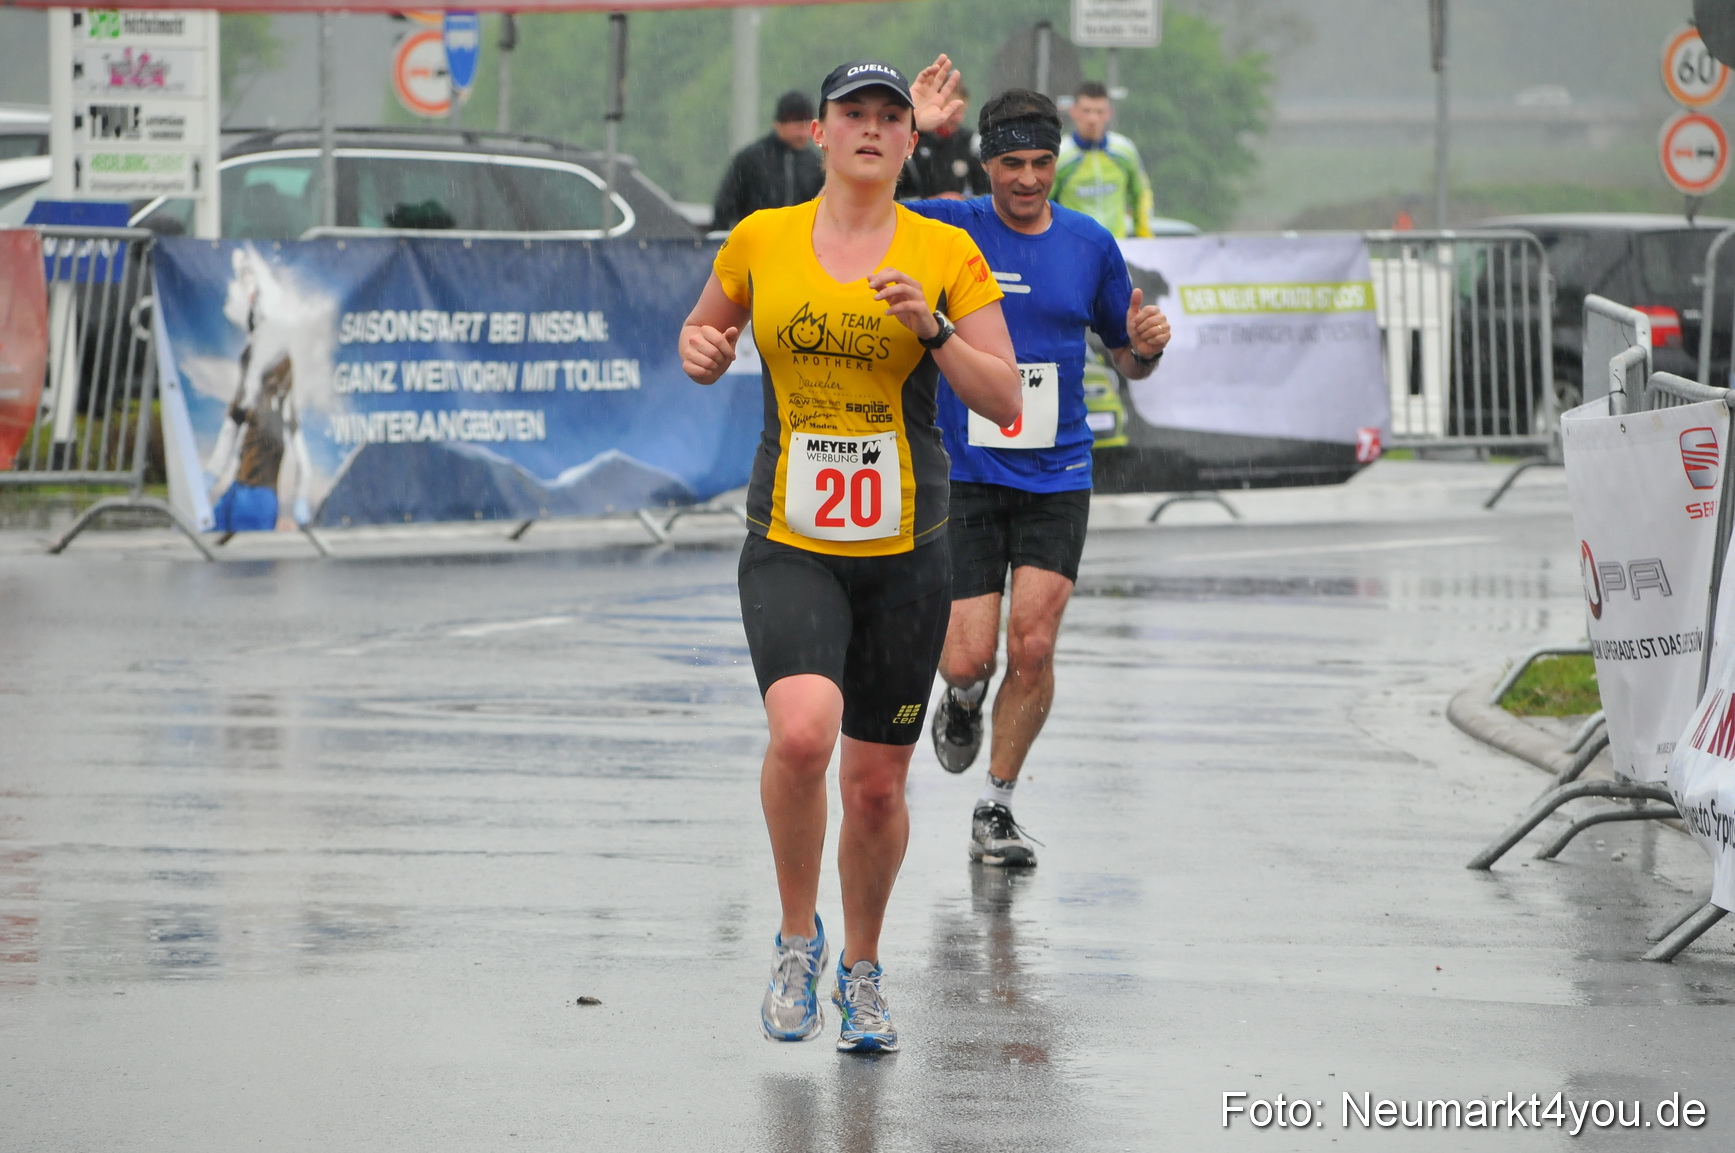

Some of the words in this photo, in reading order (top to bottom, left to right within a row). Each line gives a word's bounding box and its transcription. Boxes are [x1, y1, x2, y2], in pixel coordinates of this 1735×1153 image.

[1677, 48, 1715, 85] 60
[338, 310, 486, 344] SAISONSTART
[487, 312, 525, 344] BEI
[841, 312, 882, 332] TEAM
[792, 355, 874, 373] APOTHEKE
[333, 361, 396, 393] GANZ
[401, 361, 458, 392] WEIT
[521, 361, 561, 391] MIT
[564, 358, 641, 391] TOLLEN
[845, 401, 890, 414] sanitär
[330, 410, 546, 443] WINTERANGEBOTEN
[809, 422, 838, 430] Moden
[807, 439, 858, 454] MEYER
[806, 452, 859, 464] WERBUNG
[815, 467, 882, 528] 20
[1685, 500, 1718, 519] SEA
[1602, 639, 1638, 660] UPGRADE
[1635, 637, 1658, 659] IST
[1657, 633, 1682, 656] DAS
[892, 717, 916, 725] cep
